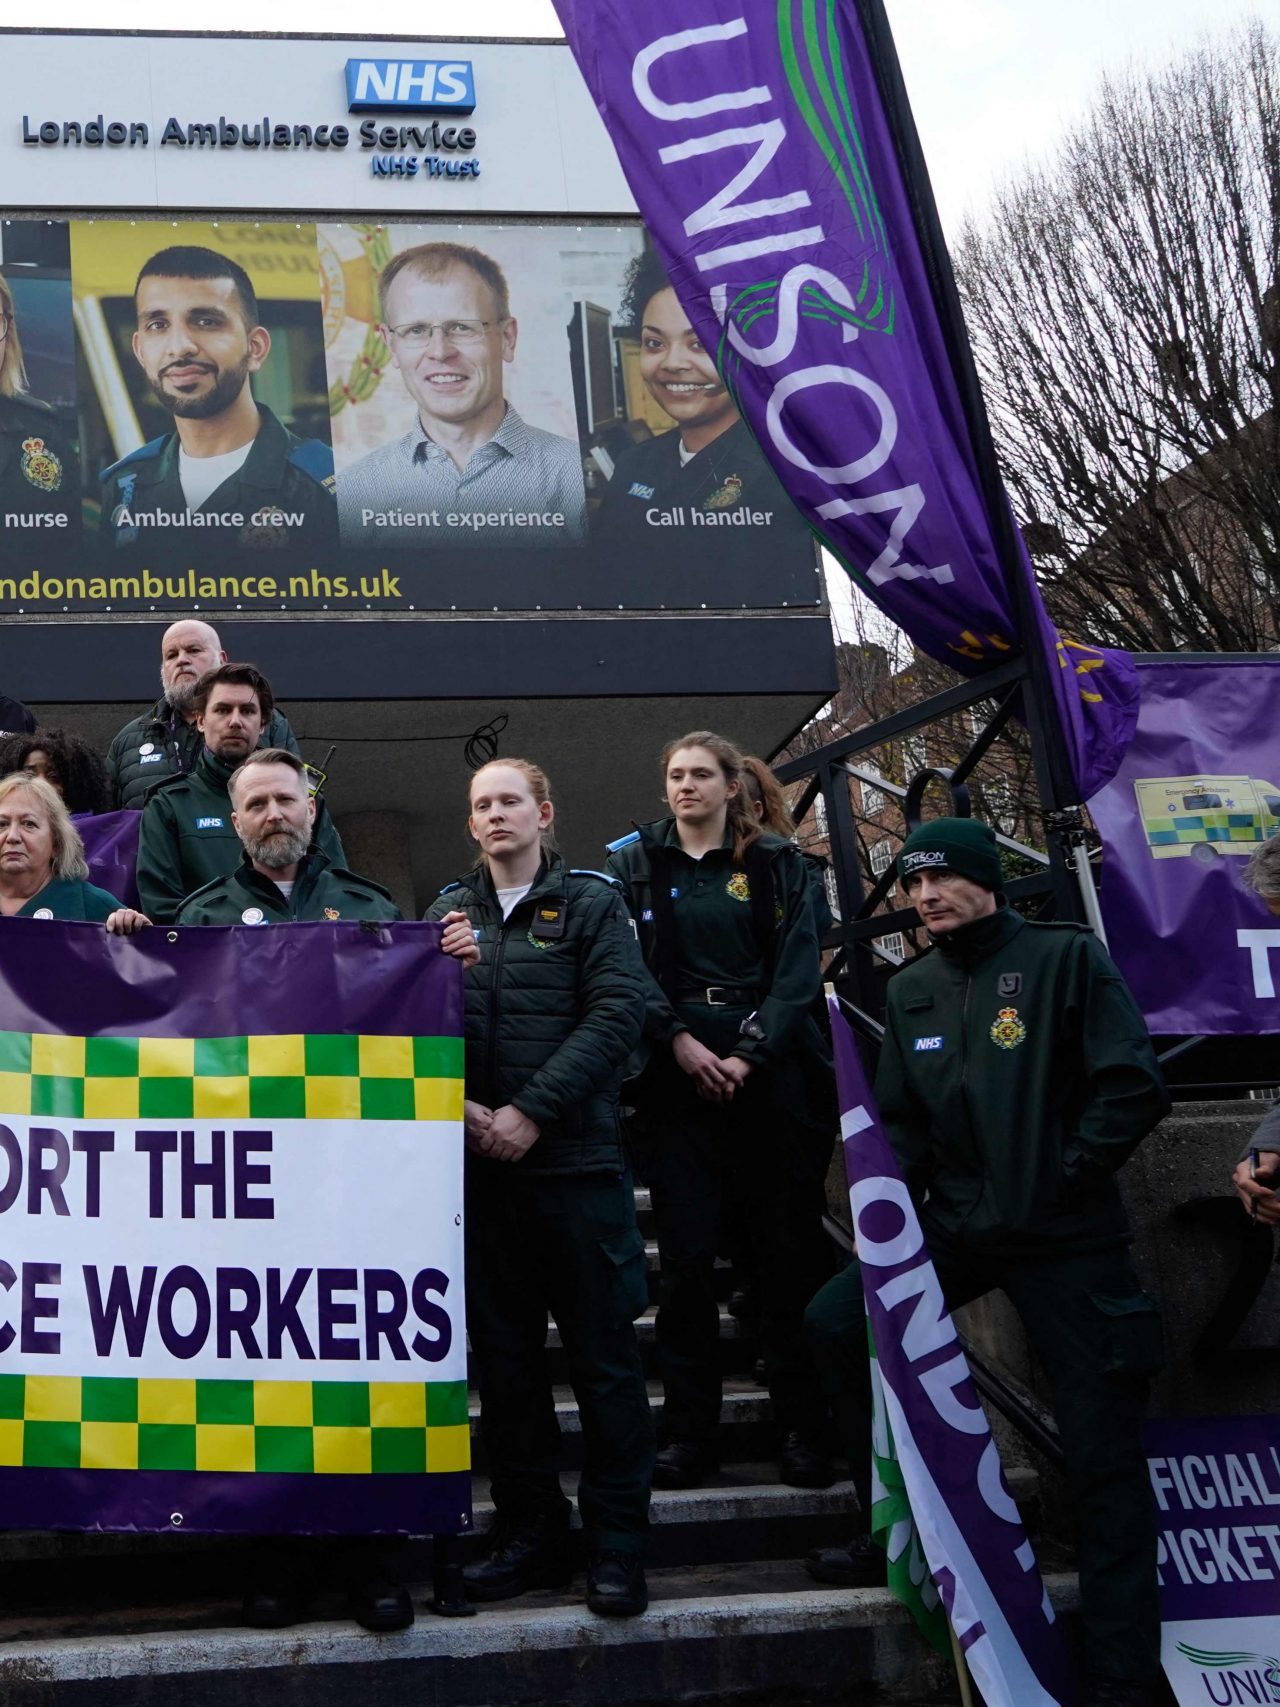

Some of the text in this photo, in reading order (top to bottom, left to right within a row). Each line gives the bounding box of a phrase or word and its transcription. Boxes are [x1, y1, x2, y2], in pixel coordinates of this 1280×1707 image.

[354, 62, 469, 103] NHS
[23, 114, 477, 150] London Ambulance Service
[372, 154, 480, 178] NHS Trust
[631, 17, 955, 588] UNISON
[629, 482, 655, 498] NHS
[5, 512, 68, 528] nurse
[117, 507, 305, 527] Ambulance crew
[361, 508, 565, 531] Patient experience
[646, 507, 774, 526] Call handler
[140, 754, 163, 764] NHS
[198, 817, 221, 828] NHS
[904, 851, 946, 869] UNISON
[915, 1036, 942, 1049] NHS
[135, 1129, 276, 1221] THE
[83, 1264, 453, 1363] WORKERS
[1147, 1447, 1280, 1512] FICIAL
